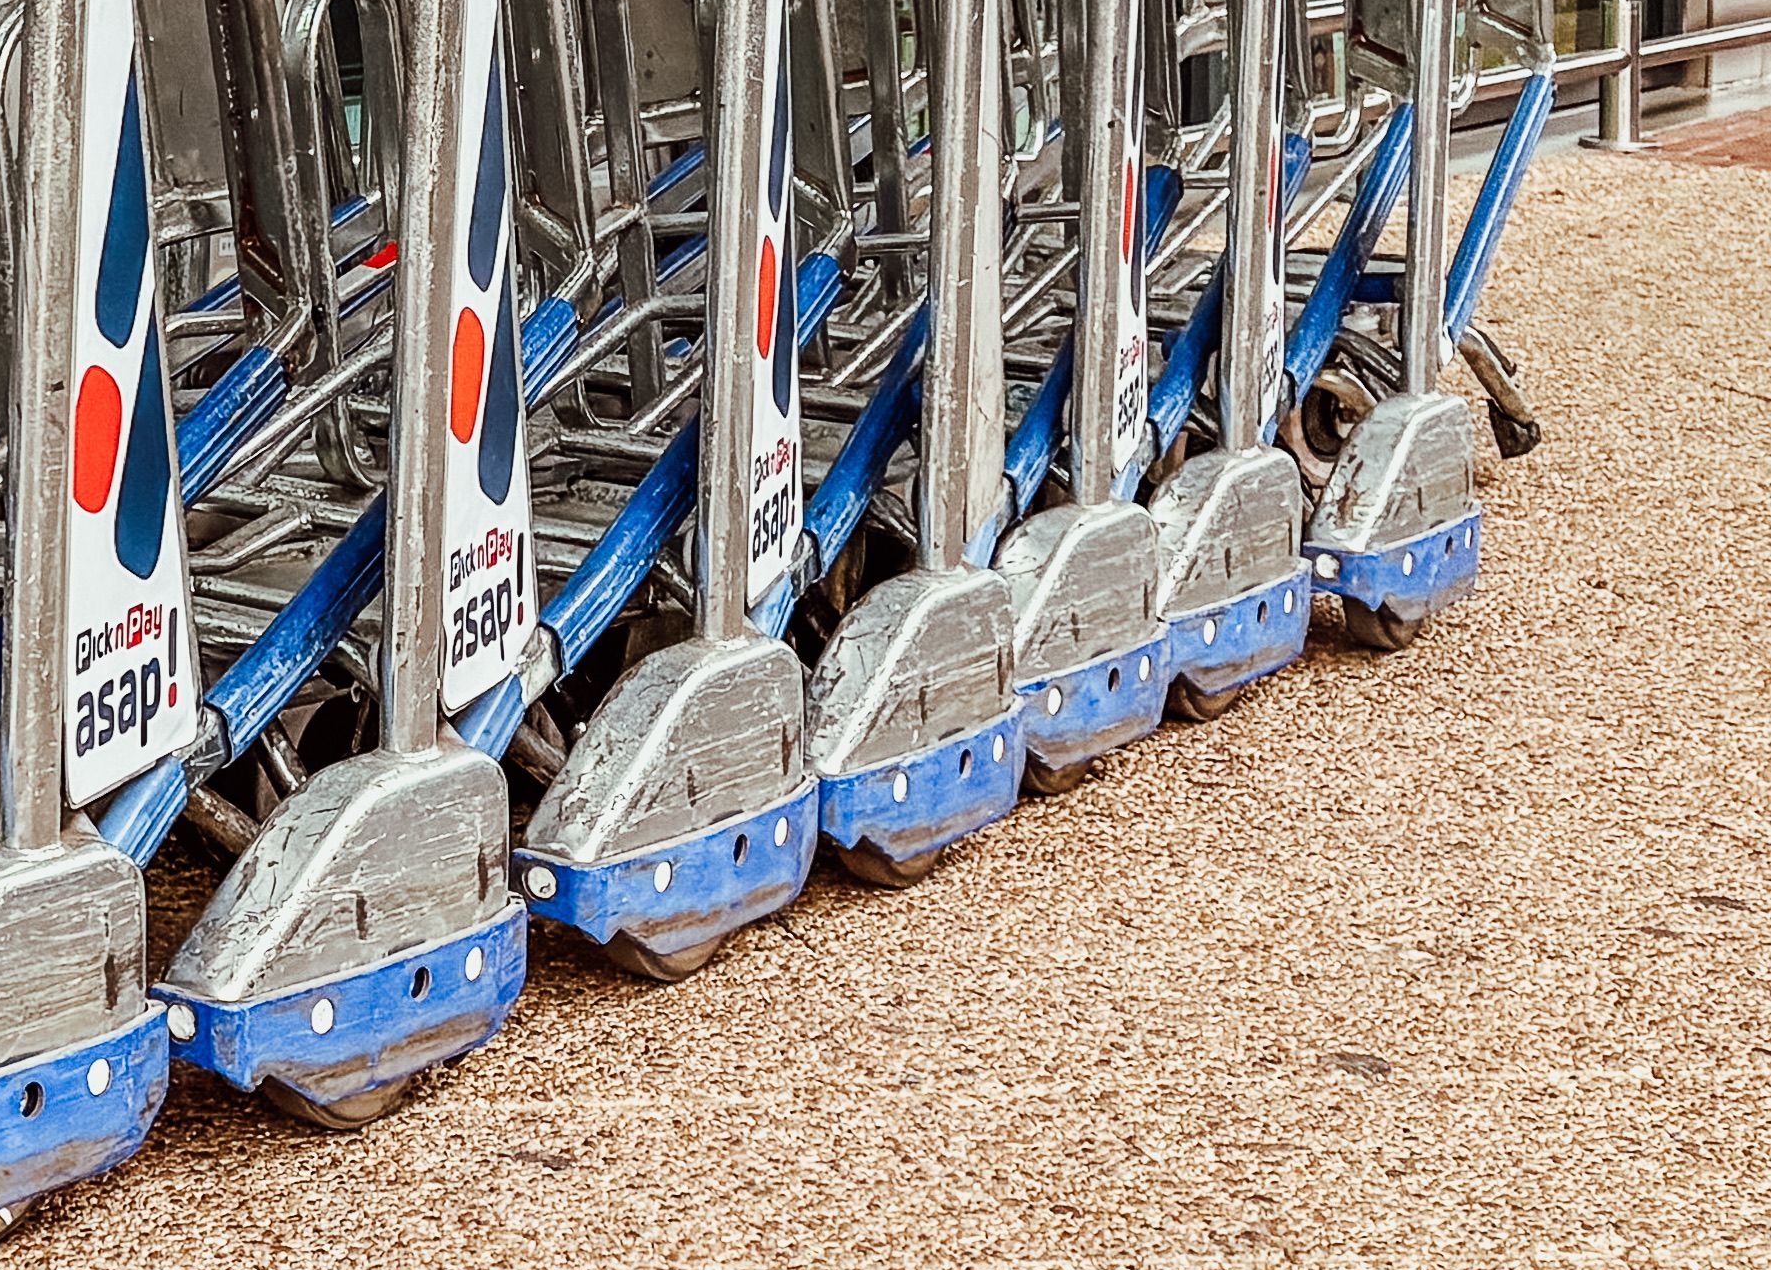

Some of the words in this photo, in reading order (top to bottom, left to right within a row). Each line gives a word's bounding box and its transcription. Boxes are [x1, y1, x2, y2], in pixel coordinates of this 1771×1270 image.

[486, 527, 514, 570] Pay
[752, 441, 796, 563] asap!
[75, 621, 113, 676] Pick
[114, 622, 125, 651] n
[126, 602, 163, 650] Pay
[451, 531, 525, 668] asap!
[75, 606, 178, 758] asap!
